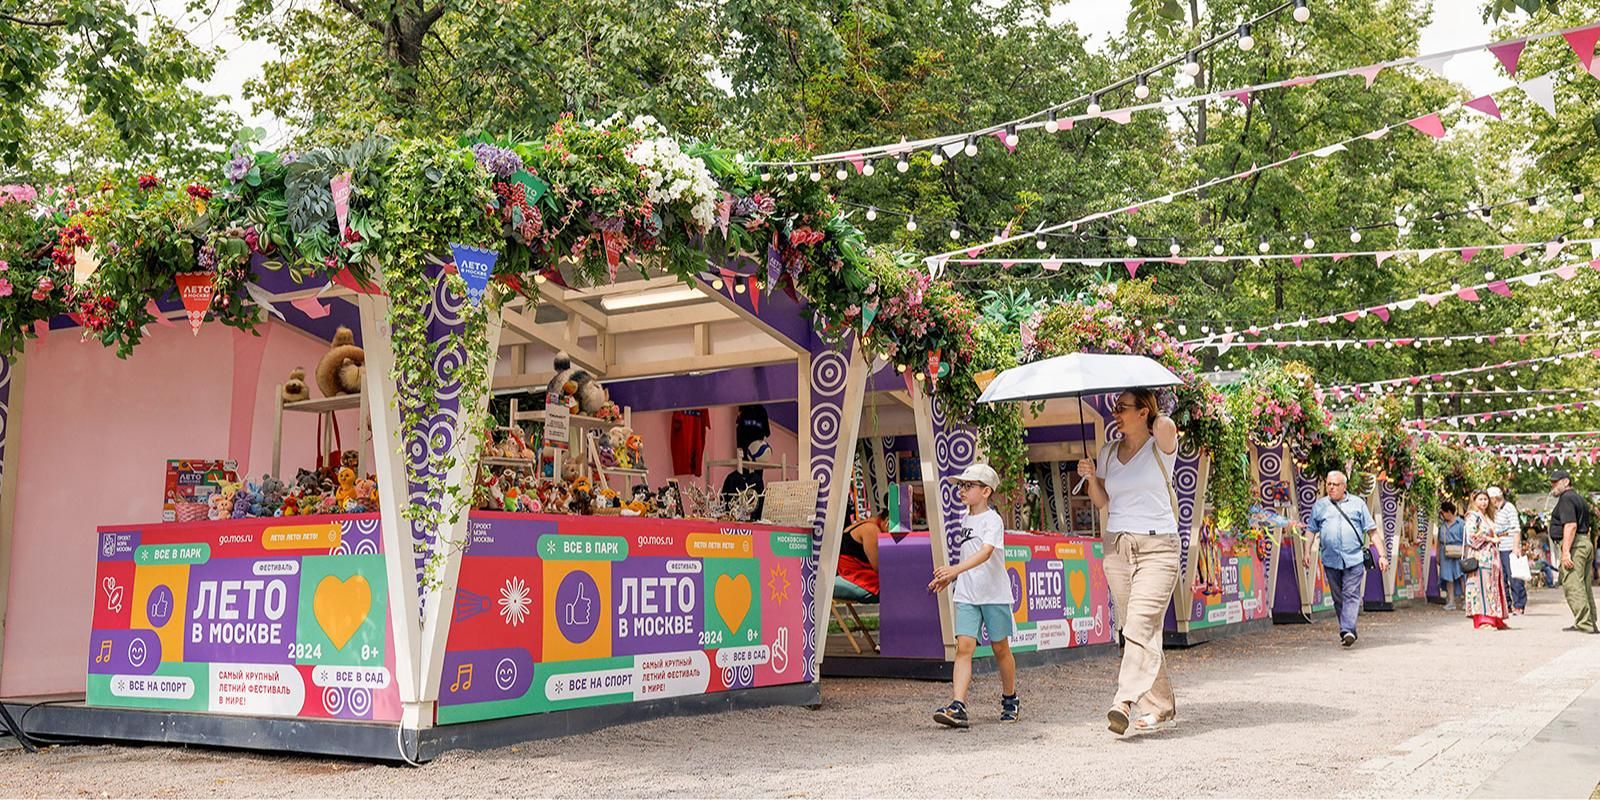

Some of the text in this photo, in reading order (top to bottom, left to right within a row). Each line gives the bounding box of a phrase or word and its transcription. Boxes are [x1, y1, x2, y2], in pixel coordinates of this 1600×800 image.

[461, 260, 488, 272] ЛЕТО
[184, 285, 211, 293] ЛЕТО
[218, 534, 253, 546] go.mos.ru
[637, 535, 674, 547] go.mos.ru
[154, 547, 202, 560] ВСЕ В ПАРК
[563, 541, 619, 554] ВСЕ В ПАРК
[259, 563, 293, 571] ФЕСТИВАЛЬ
[671, 563, 698, 571] ФЕСТИВАЛЬ
[1029, 571, 1062, 596] ЛЕТО
[192, 579, 287, 620] ЛЕТО
[618, 576, 696, 615] ЛЕТО
[1030, 596, 1061, 610] В МОСКВЕ
[192, 622, 282, 644] В МОСКВЕ
[618, 615, 694, 638] В МОСКВЕ
[698, 630, 723, 645] 2024
[747, 628, 758, 641] 0+
[287, 642, 322, 659] 2024
[361, 644, 379, 660] 0+
[733, 649, 766, 662] ВСЕ В САД
[642, 657, 692, 670] САМЫЙ КРУПНЫЙ
[218, 670, 280, 682] САМЫЙ КРУПНЫЙ
[336, 671, 384, 684] ВСЕ В САД
[569, 674, 633, 691] ВСЕ НА СПОРТ
[642, 670, 700, 682] ЛЕТНИЙ ФЕСТИВАЛЬ
[129, 680, 187, 693] ВСЕ НА СПОРТ
[218, 683, 291, 695] ЛЕТНИЙ ФЕСТИВАЛЬ
[642, 684, 666, 694] В МИРЕ!
[218, 696, 246, 706] В МИРЕ!
